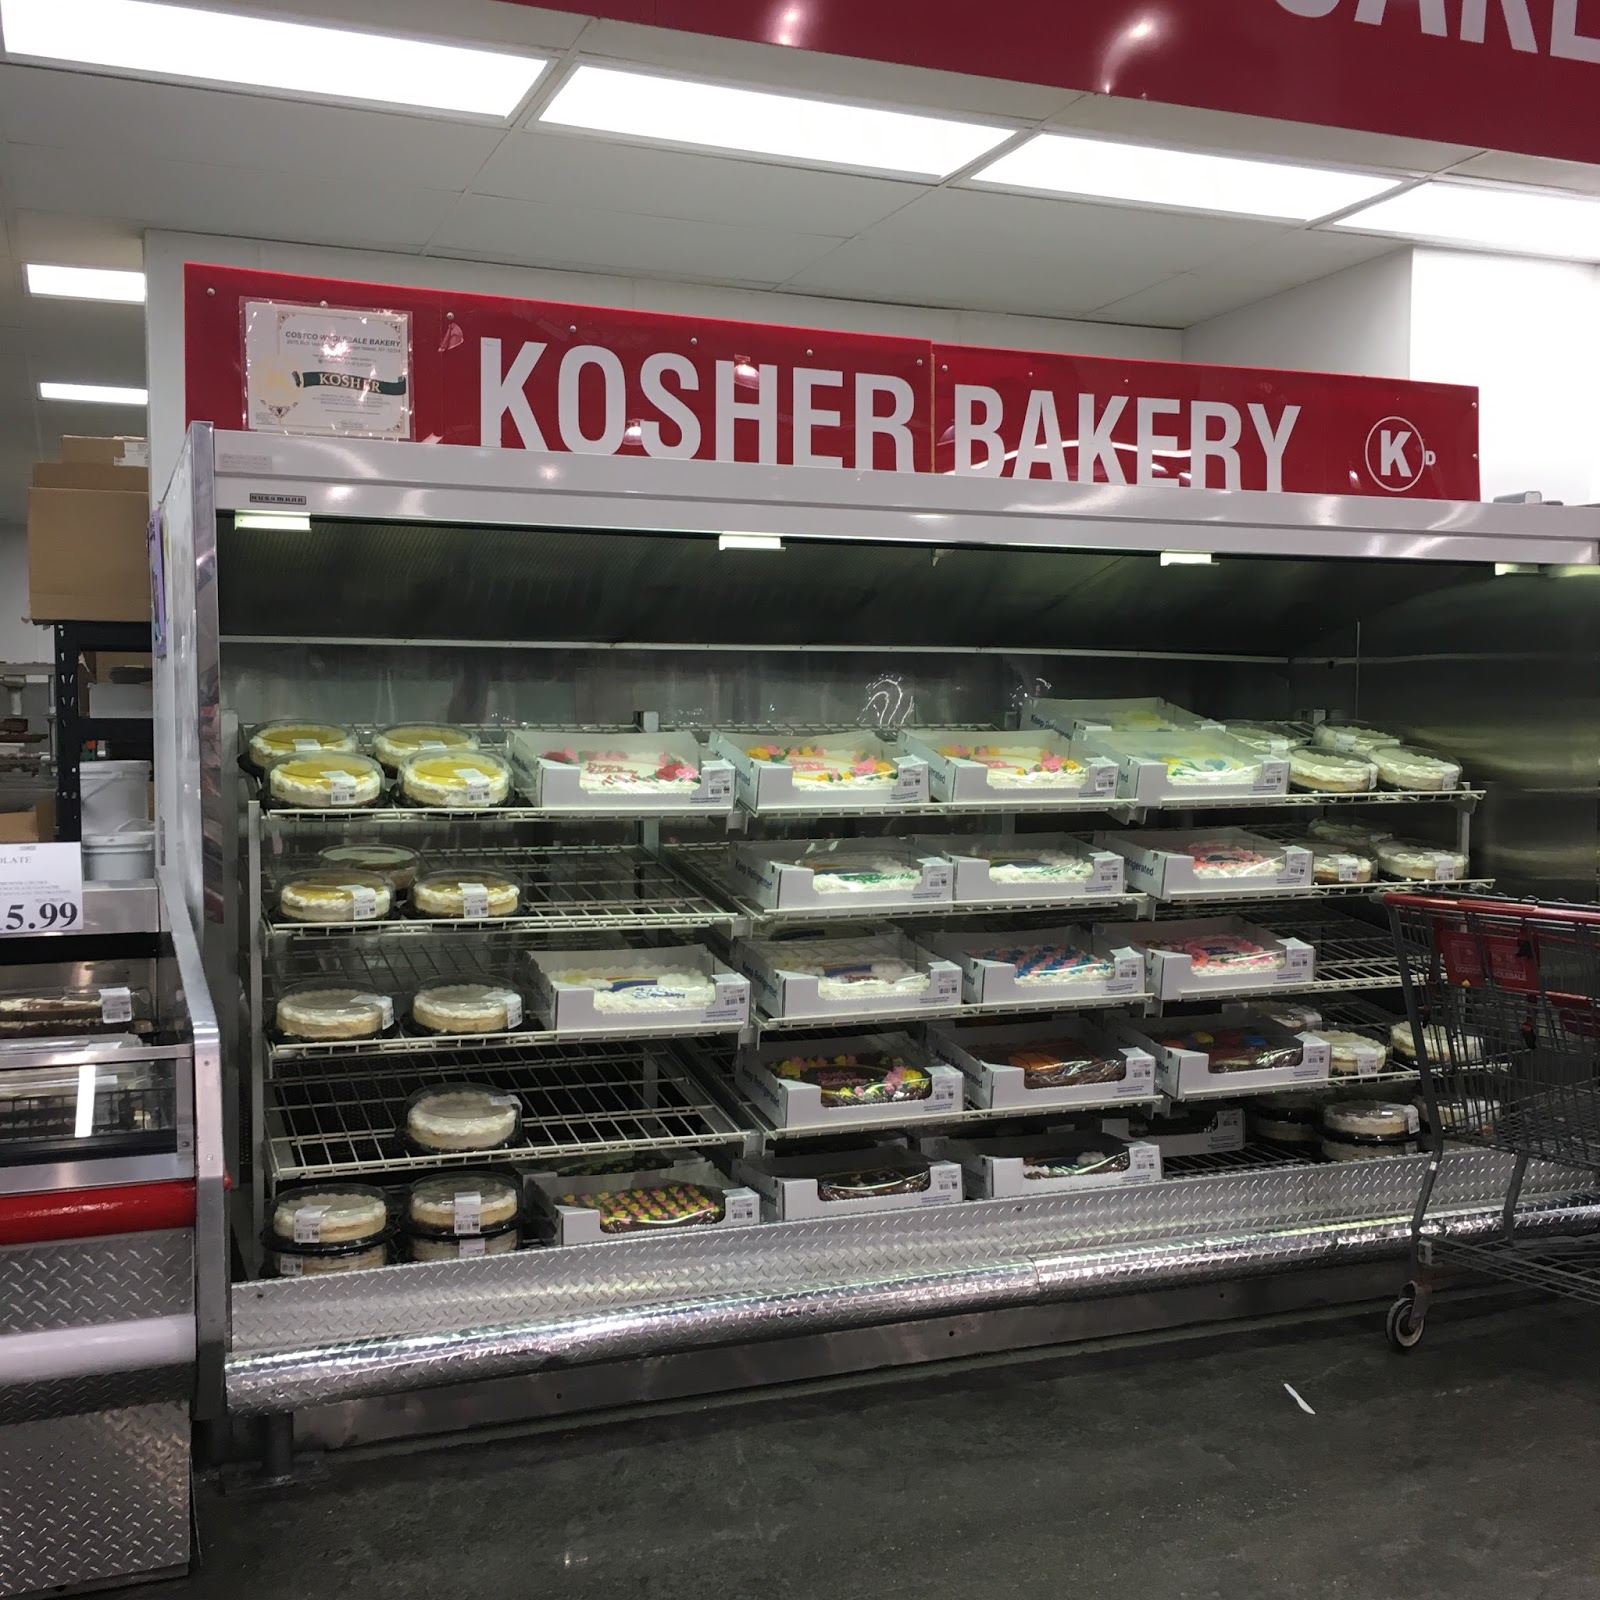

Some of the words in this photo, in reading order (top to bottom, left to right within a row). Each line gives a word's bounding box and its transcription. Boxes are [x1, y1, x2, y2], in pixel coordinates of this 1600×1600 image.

[285, 331, 319, 340] COSTCO
[319, 373, 382, 393] KOSHER
[480, 337, 915, 473] KOSHER
[954, 384, 1301, 492] BAKERY
[0, 902, 78, 930] 5.99
